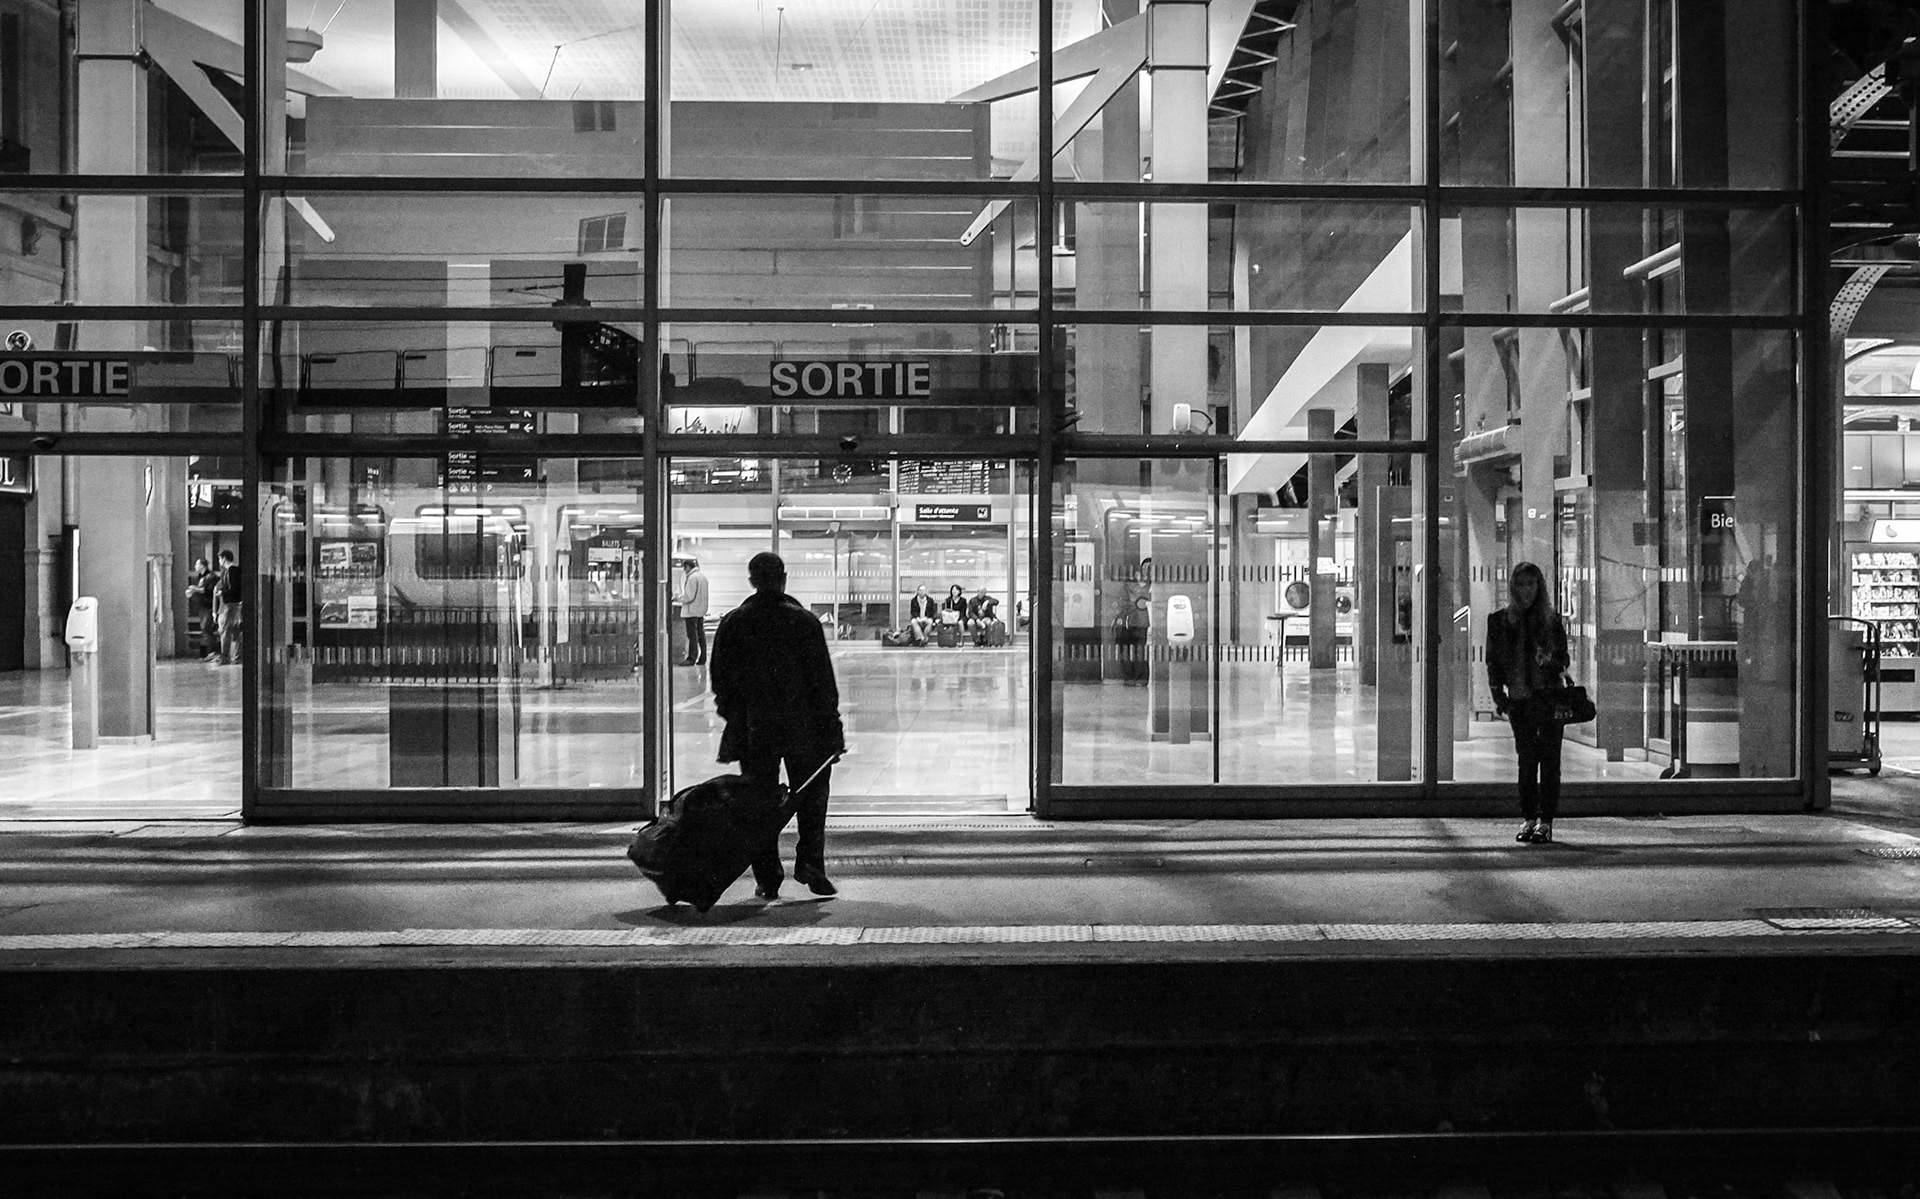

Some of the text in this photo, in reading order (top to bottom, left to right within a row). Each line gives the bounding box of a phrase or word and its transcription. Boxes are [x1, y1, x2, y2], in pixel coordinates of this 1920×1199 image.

[772, 362, 930, 396] SORTIE
[448, 452, 468, 460] Sortie
[448, 467, 468, 475] Sortie
[919, 507, 959, 515] Salle d'attente
